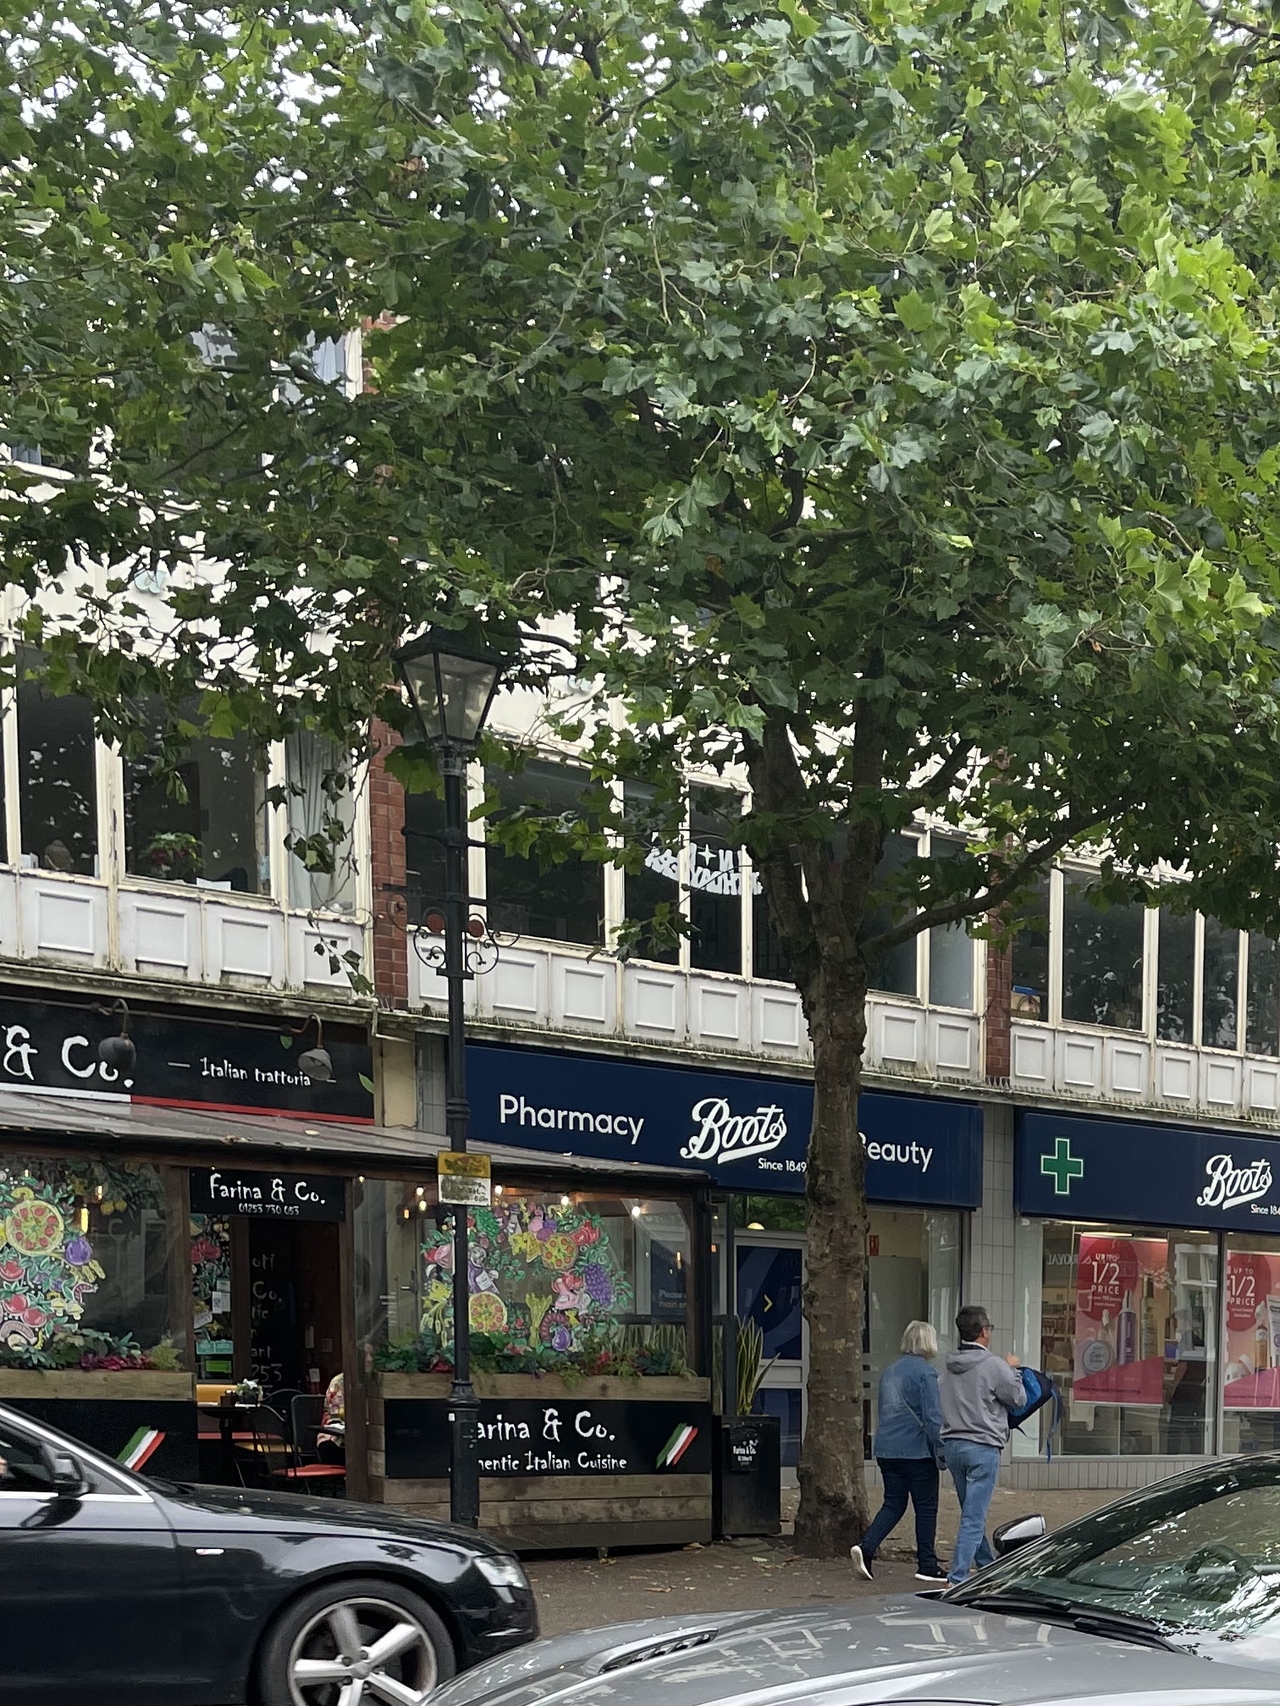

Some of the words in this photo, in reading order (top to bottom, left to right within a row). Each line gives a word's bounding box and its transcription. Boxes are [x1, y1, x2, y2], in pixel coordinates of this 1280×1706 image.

[200, 1056, 248, 1081] Italian
[255, 1065, 311, 1087] trattoria
[499, 1094, 644, 1145] Pharmacy
[679, 1097, 787, 1164] Boots
[758, 1158, 783, 1172] Since
[786, 1159, 807, 1173] 1849
[209, 1173, 263, 1200] Farina
[270, 1178, 286, 1202] &
[294, 1181, 326, 1205] Co.
[1196, 1154, 1273, 1210] Boots
[238, 1203, 263, 1214] 01253
[265, 1204, 282, 1215] 730
[284, 1204, 300, 1216] 053
[1250, 1203, 1269, 1215] Since
[1091, 1261, 1120, 1285] 1/2
[1245, 1267, 1254, 1275] TO
[1091, 1285, 1120, 1295] PRICE
[1230, 1275, 1256, 1297] 1/2
[1230, 1297, 1256, 1306] PRICE
[477, 1414, 530, 1441] arina
[542, 1408, 562, 1442] &
[575, 1410, 615, 1441] Co.
[524, 1450, 571, 1471] Italian
[578, 1451, 627, 1471] Cuisine
